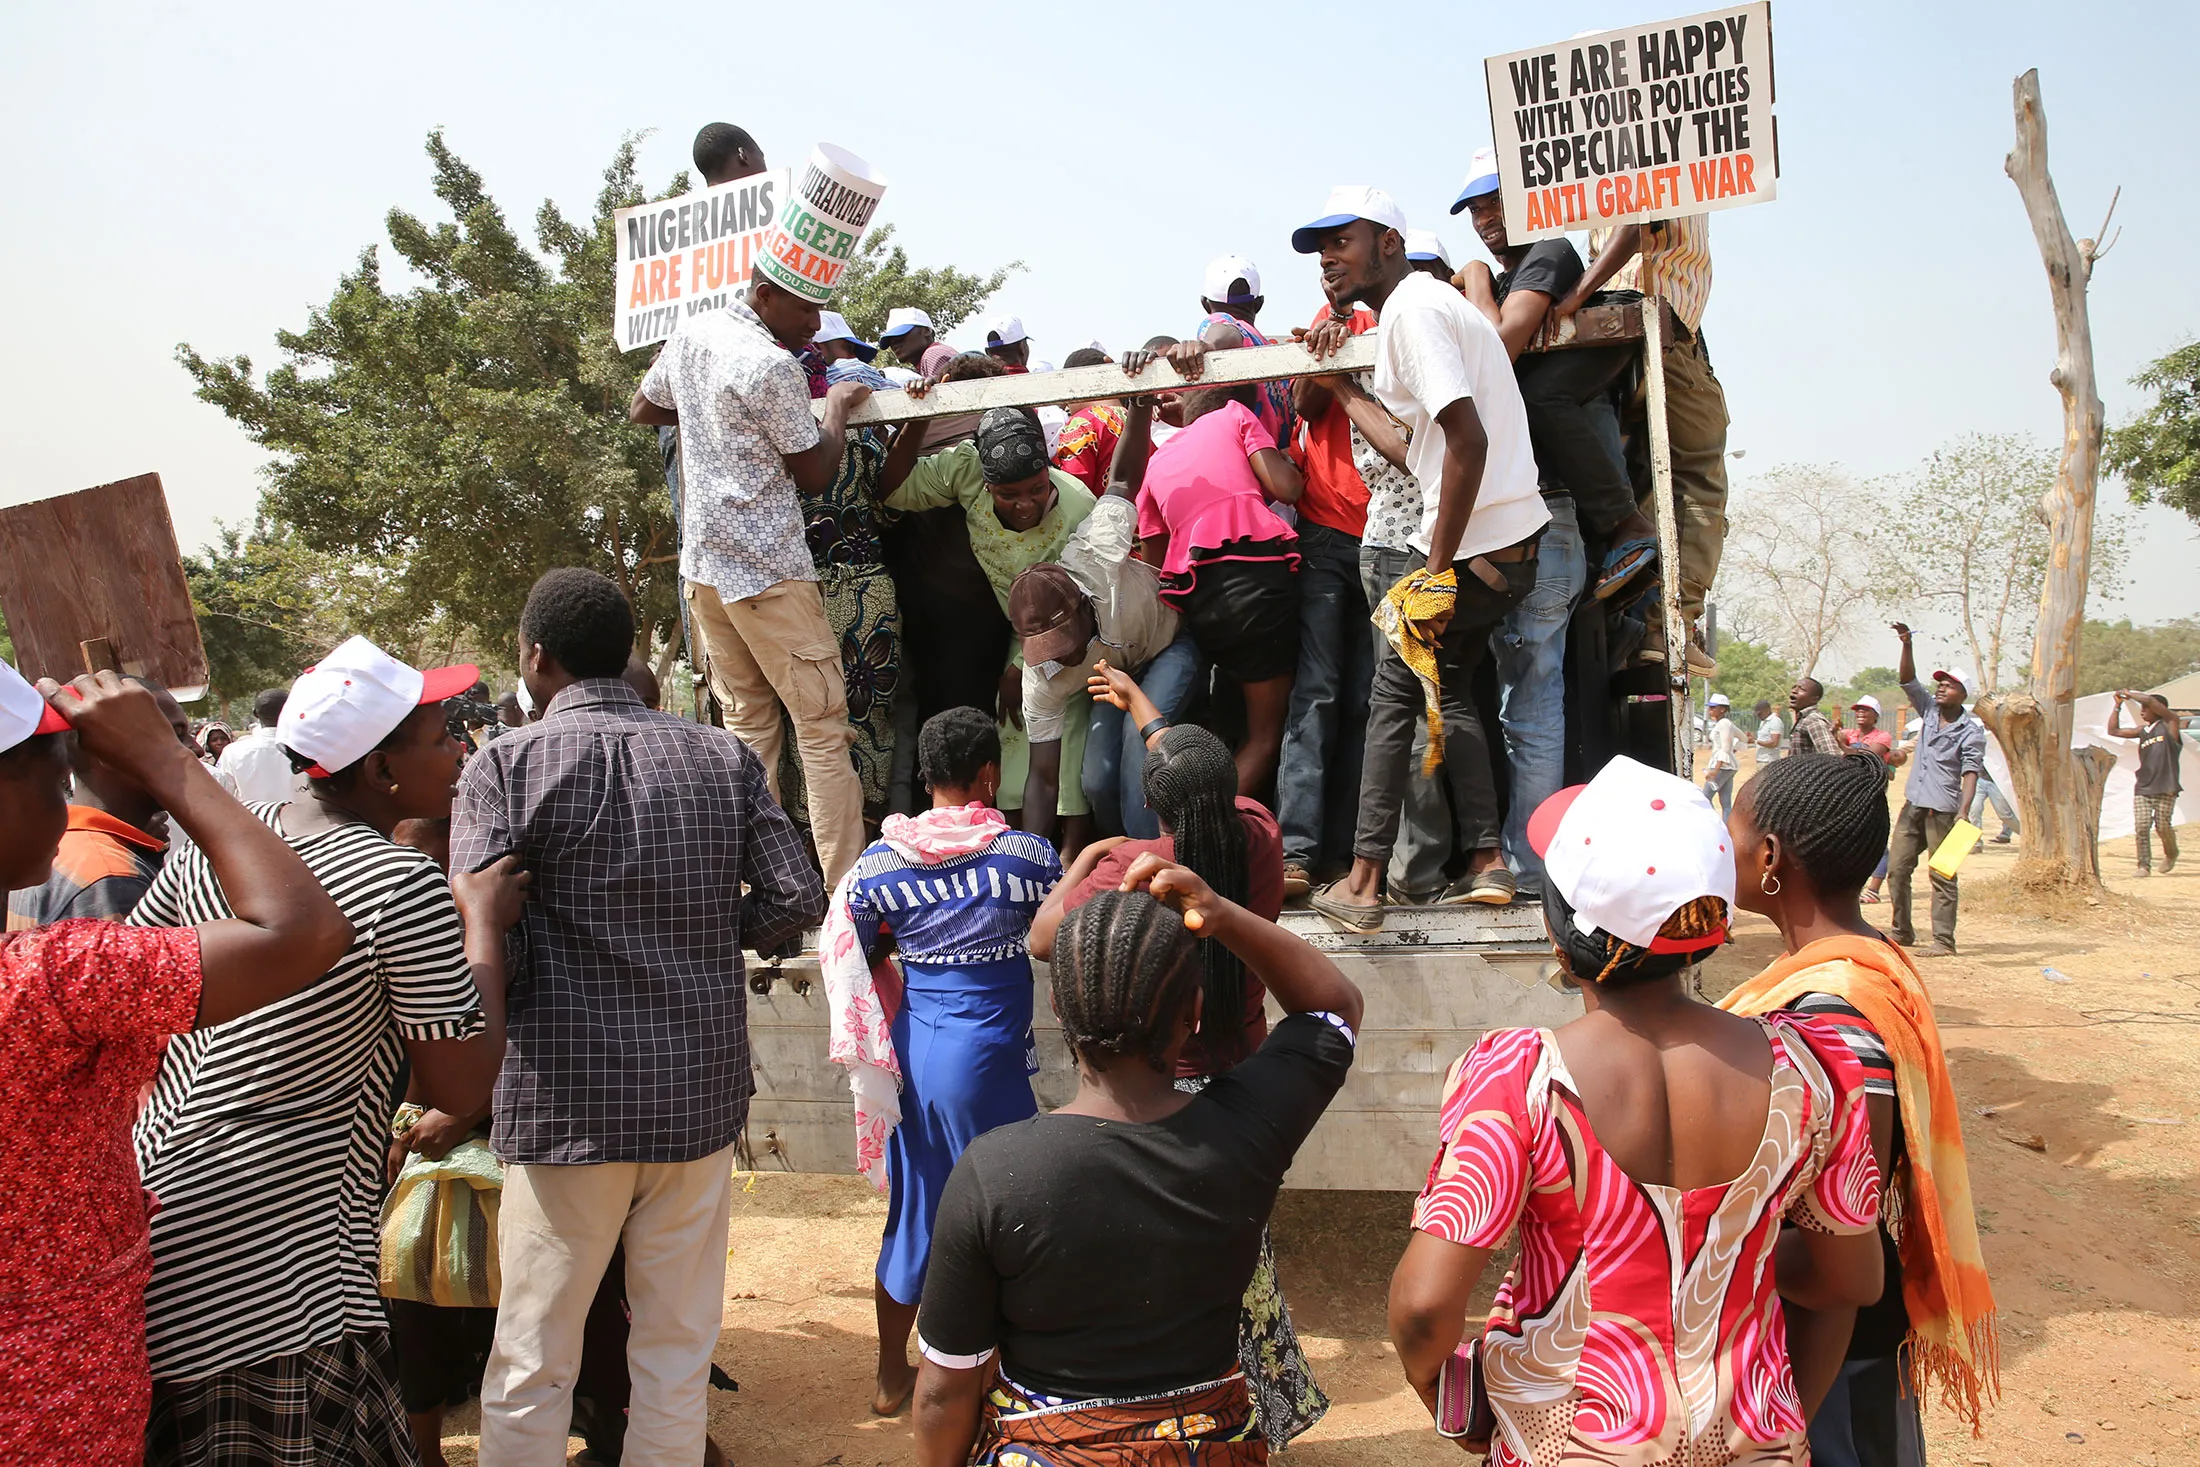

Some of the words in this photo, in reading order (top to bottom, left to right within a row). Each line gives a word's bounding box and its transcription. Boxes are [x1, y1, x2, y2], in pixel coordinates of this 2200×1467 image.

[1508, 53, 1559, 106] WE
[1569, 39, 1629, 97] ARE
[1637, 14, 1748, 83] HAPPY
[1514, 100, 1574, 142] WITH
[1580, 88, 1643, 130] YOUR
[1650, 66, 1750, 118] POLICIES
[1519, 116, 1682, 189] ESPECIALLY
[1692, 104, 1750, 157] THE
[1526, 183, 1588, 232] ANTI
[1595, 166, 1681, 219] GRAFT
[1688, 153, 1756, 202] WAR
[628, 181, 774, 260] NIGERIANS
[629, 254, 682, 309] ARE
[777, 267, 801, 287] YOU
[801, 283, 824, 297] SIR!
[628, 305, 679, 345] WITH
[1037, 1400, 1098, 1417] SWITZERLAND
[1101, 1398, 1110, 1407] IN
[1174, 1388, 1191, 1397] WAX
